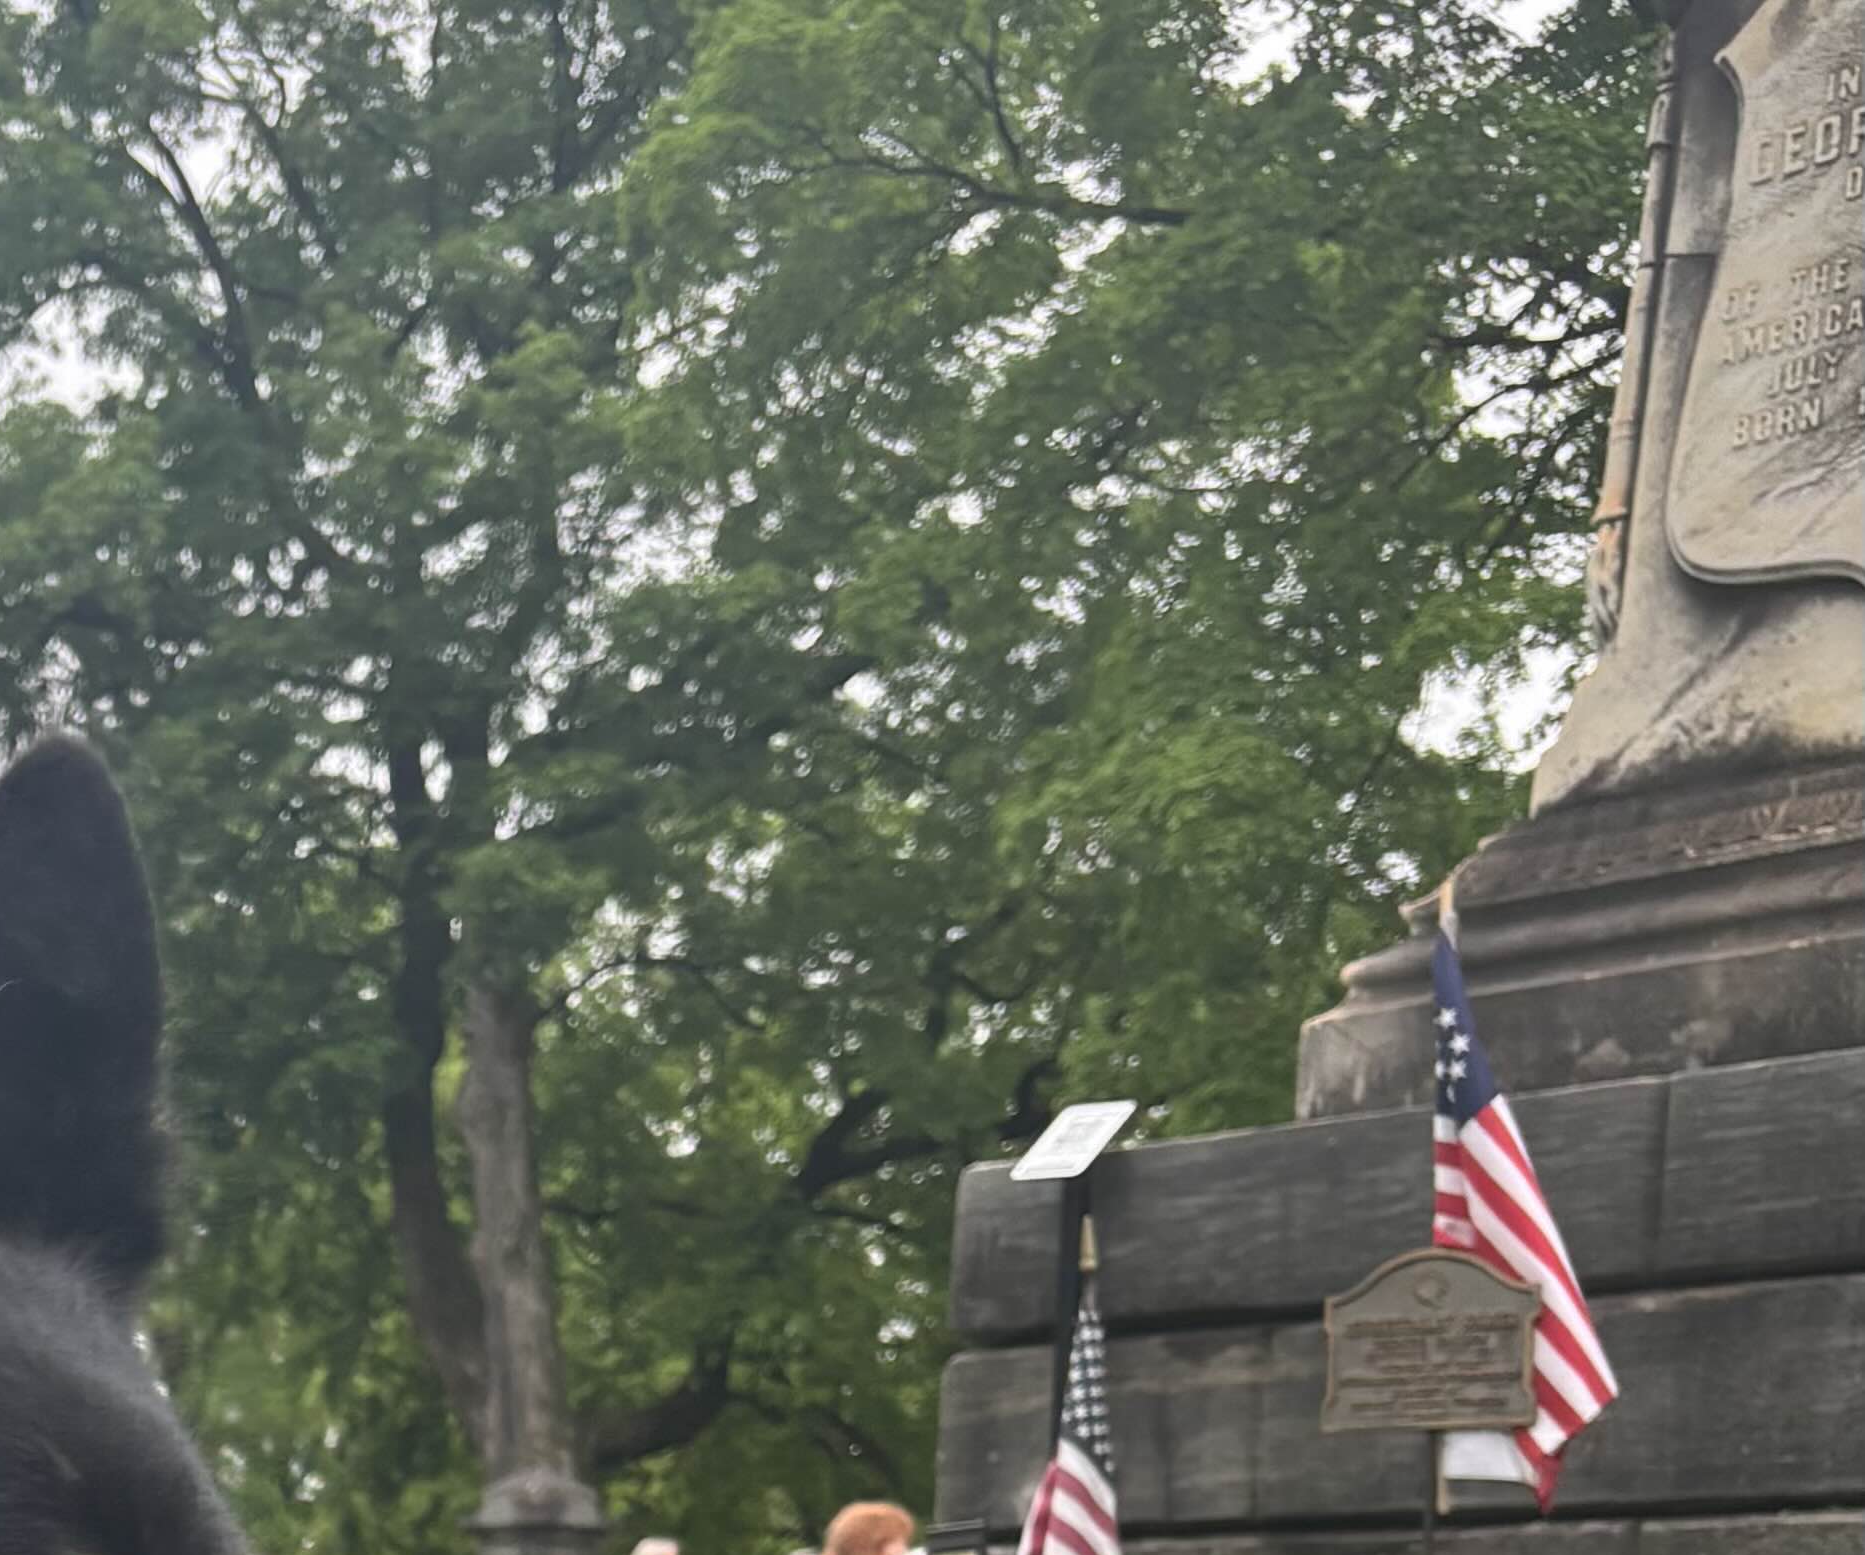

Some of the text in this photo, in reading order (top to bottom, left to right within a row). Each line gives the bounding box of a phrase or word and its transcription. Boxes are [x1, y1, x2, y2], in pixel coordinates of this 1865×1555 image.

[1789, 256, 1850, 302] THE
[1766, 348, 1843, 398] JULY
[1732, 397, 1822, 449] BORN
